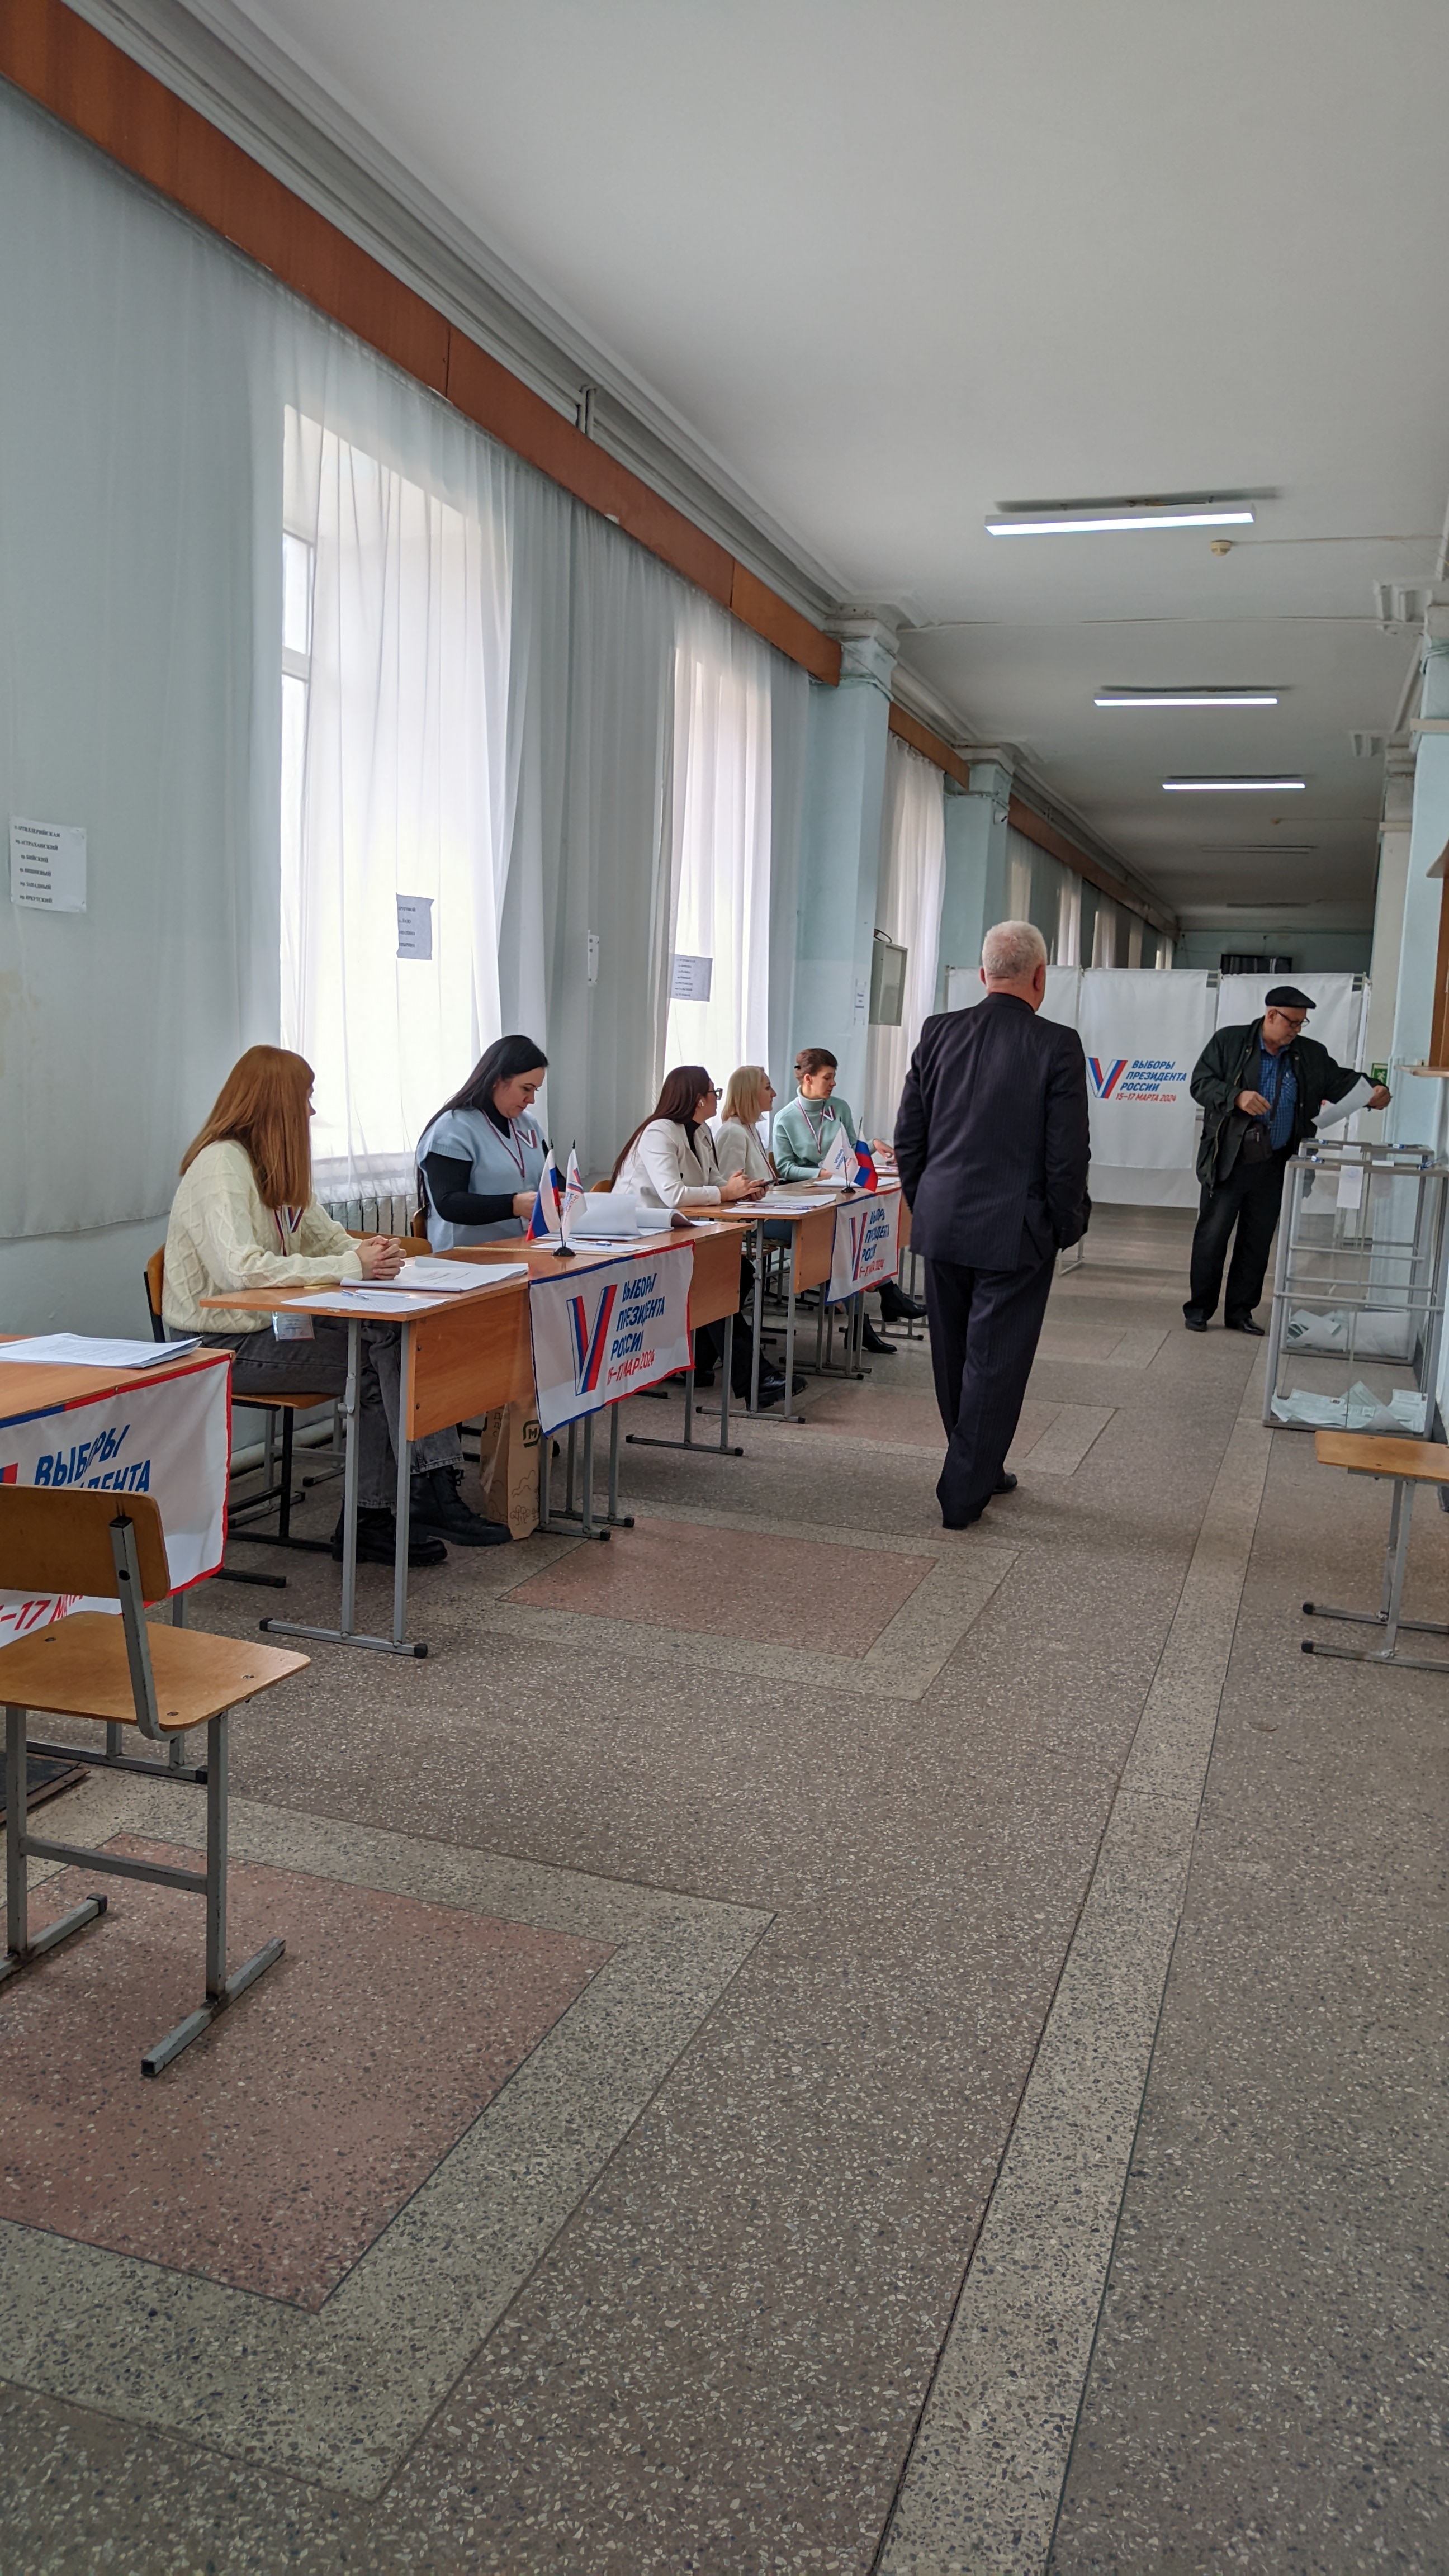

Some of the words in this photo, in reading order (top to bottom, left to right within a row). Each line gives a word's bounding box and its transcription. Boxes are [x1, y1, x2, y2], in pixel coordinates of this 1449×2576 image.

[1131, 1060, 1175, 1070] ВЫБОРЫ
[1126, 1071, 1187, 1082] ПРЕЗИДЕНТА
[1120, 1083, 1160, 1092] РОССИИ
